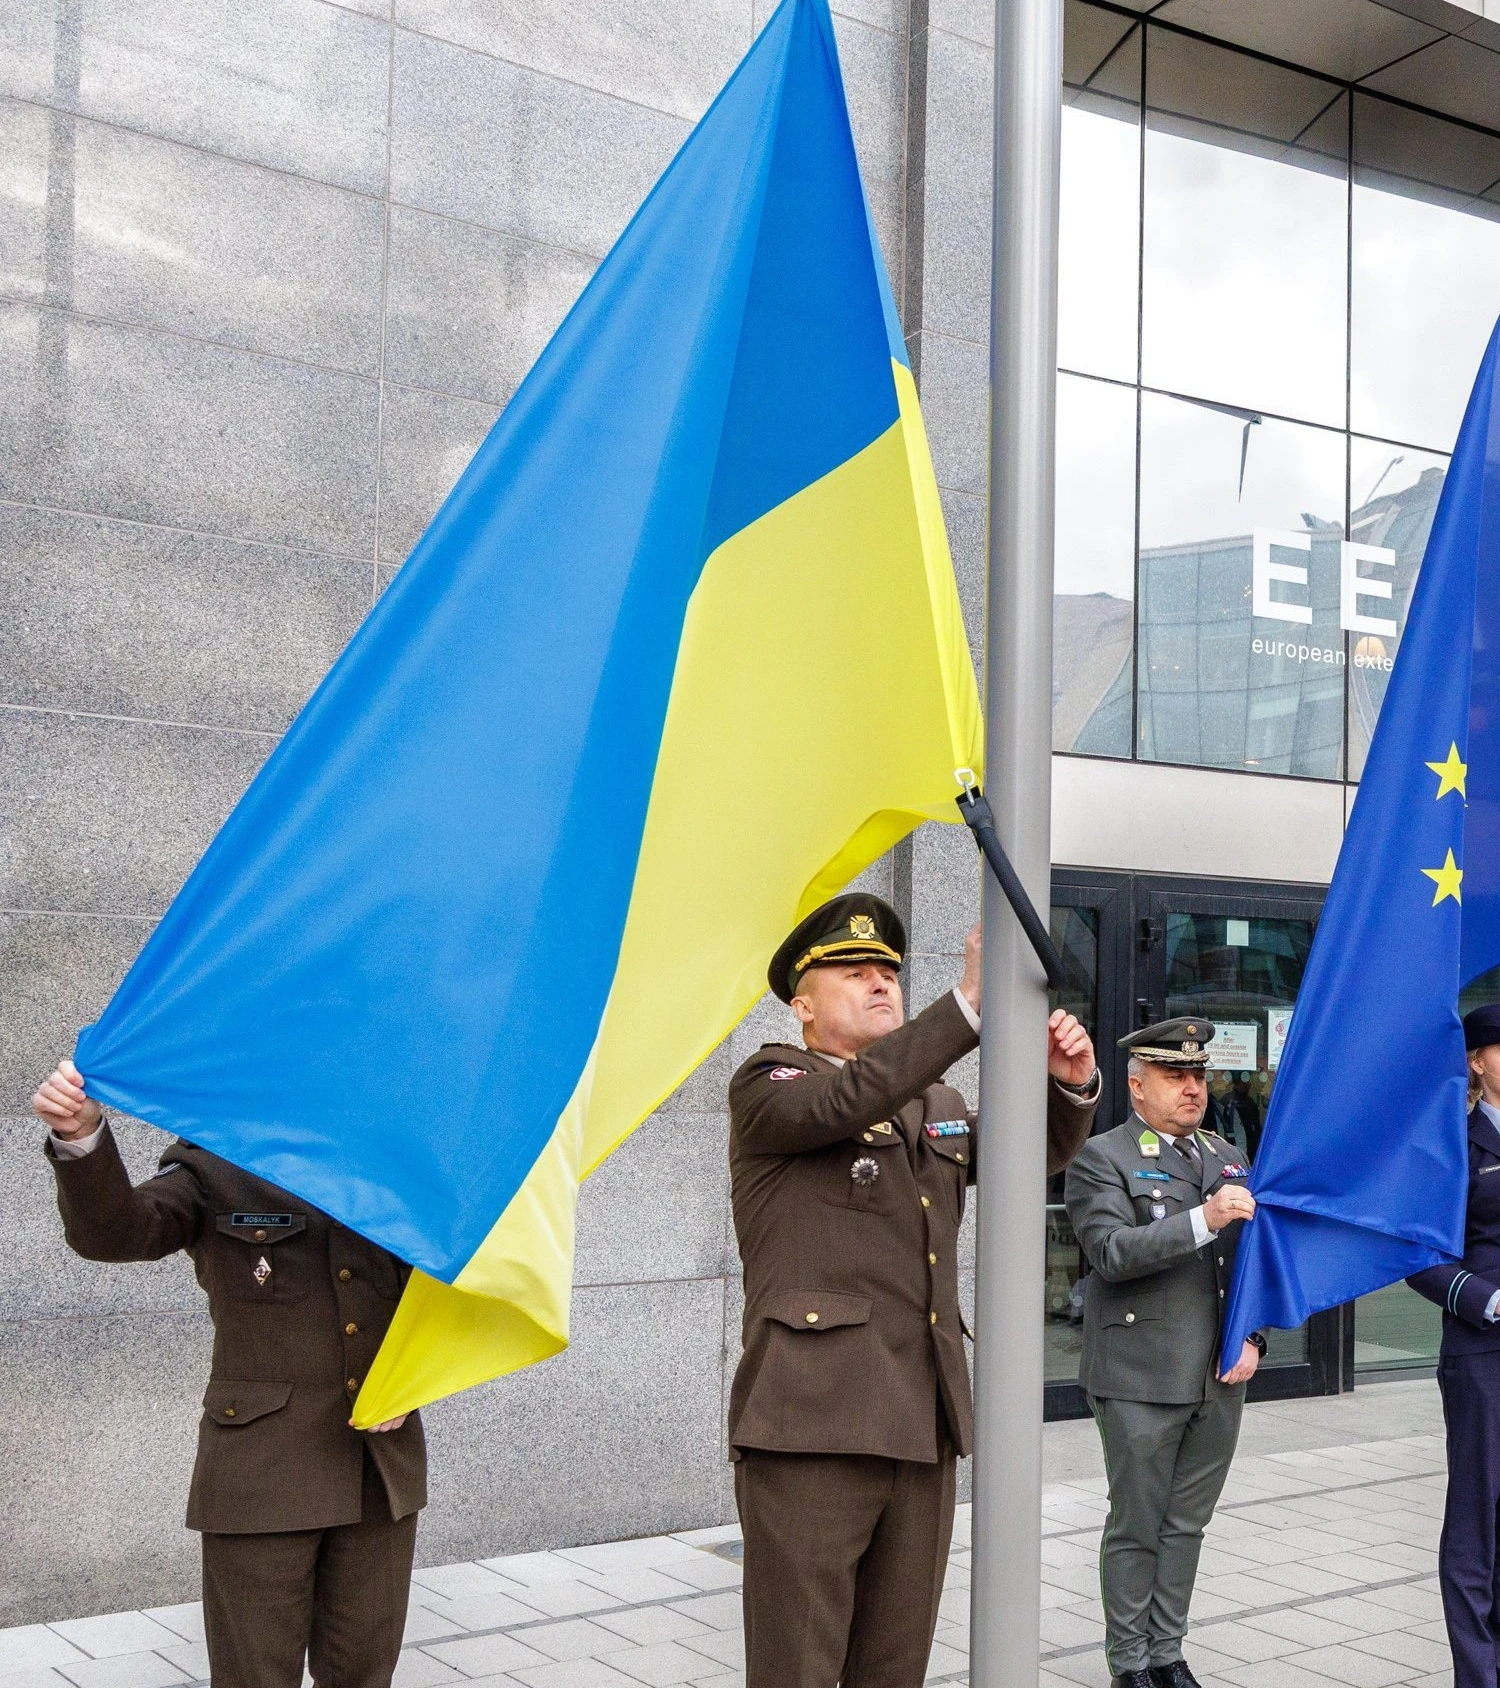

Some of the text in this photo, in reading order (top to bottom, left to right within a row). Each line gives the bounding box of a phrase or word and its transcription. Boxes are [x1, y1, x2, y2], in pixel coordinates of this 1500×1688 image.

[1252, 526, 1398, 638] EE
[1252, 638, 1394, 672] european exte
[243, 1215, 280, 1224] MOSKALYK
